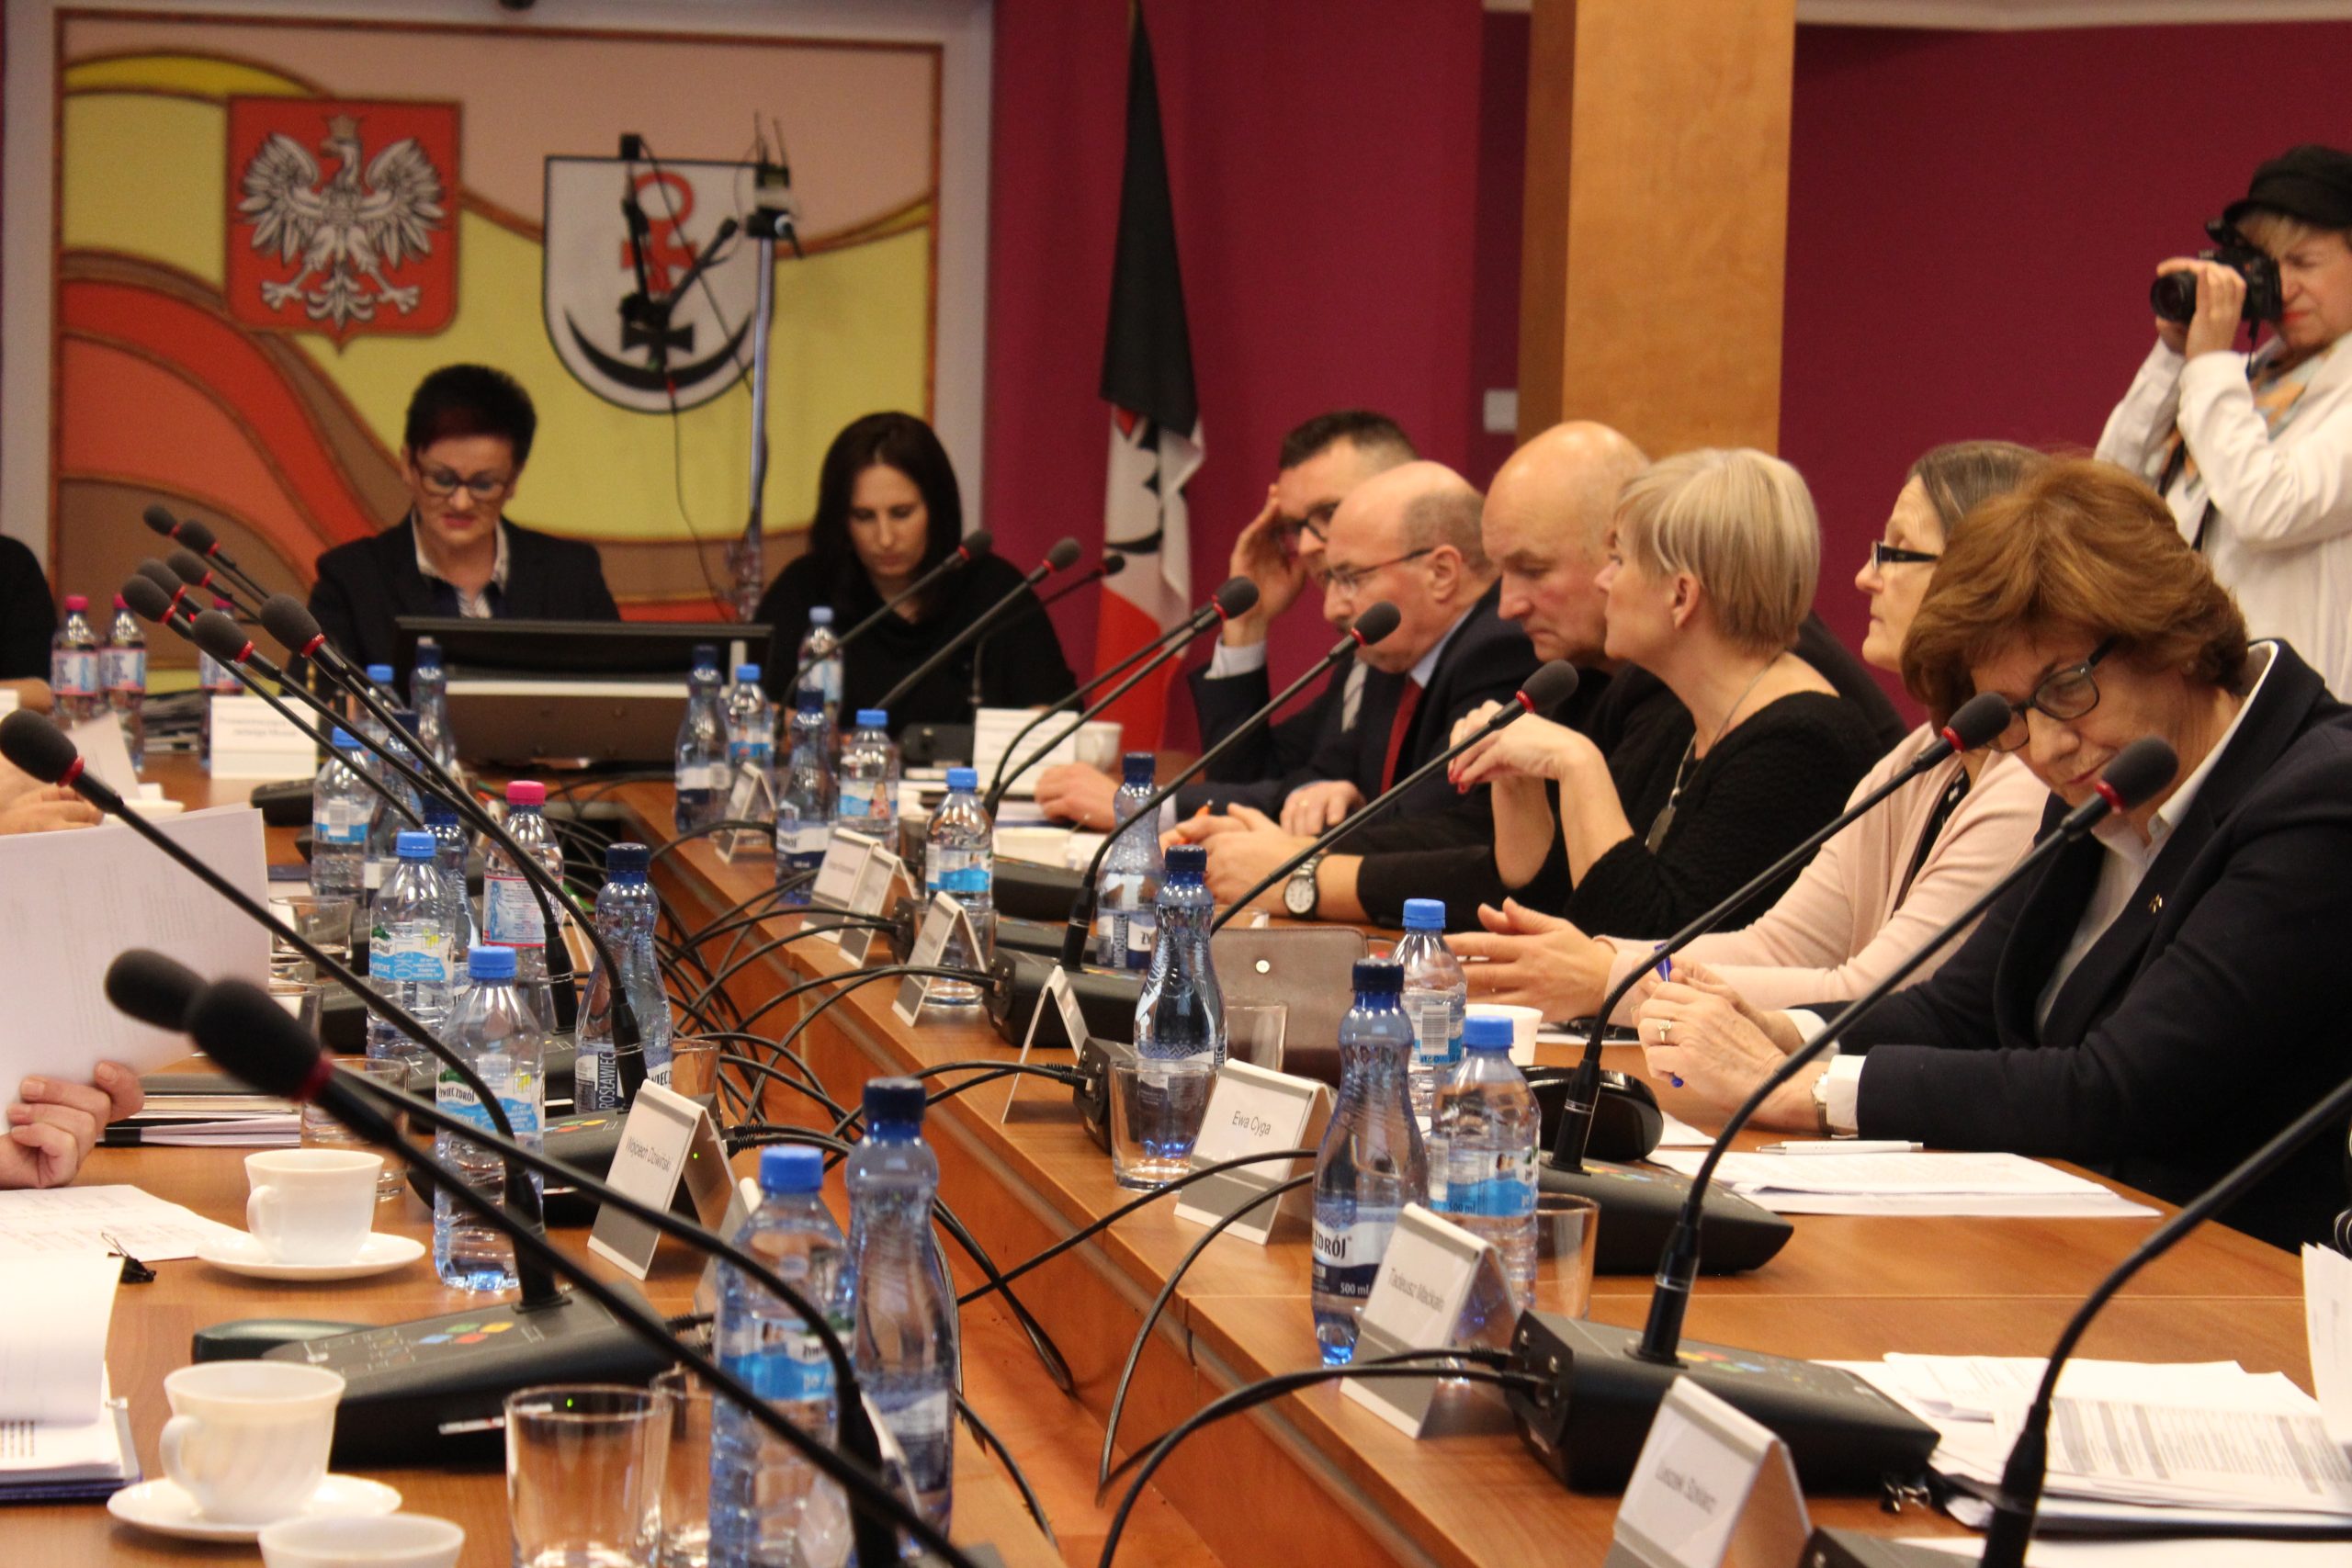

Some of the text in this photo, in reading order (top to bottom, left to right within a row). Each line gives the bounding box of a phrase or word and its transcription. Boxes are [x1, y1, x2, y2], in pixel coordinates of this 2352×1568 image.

[1232, 1110, 1272, 1137] Ewa Cyga
[1340, 1282, 1355, 1294] 500
[1357, 1284, 1369, 1296] ml
